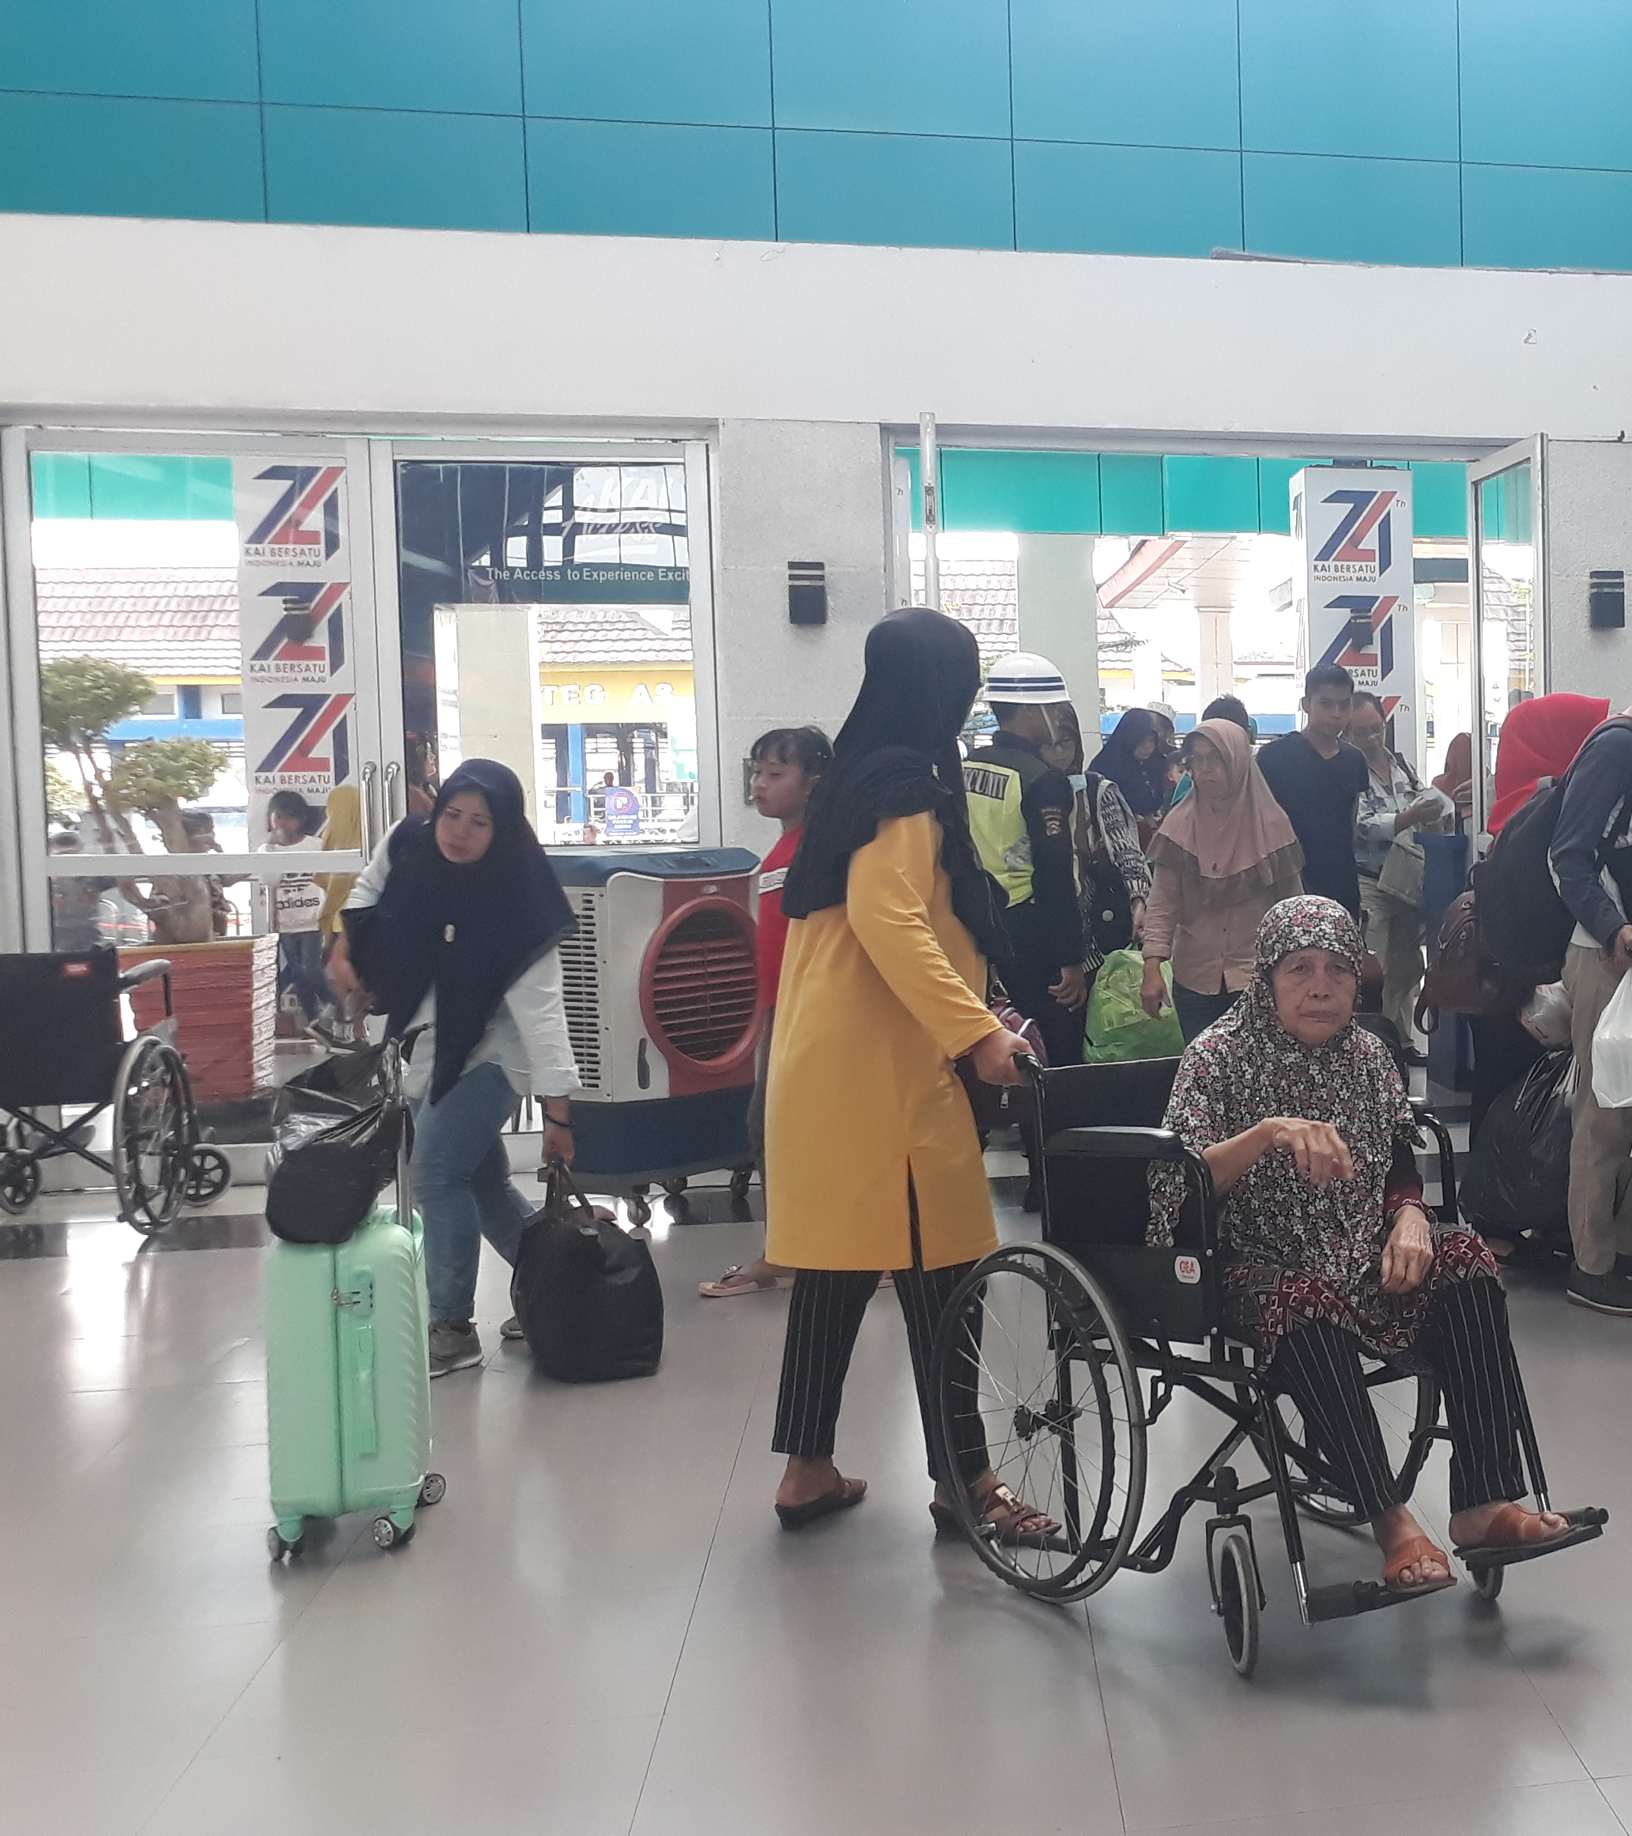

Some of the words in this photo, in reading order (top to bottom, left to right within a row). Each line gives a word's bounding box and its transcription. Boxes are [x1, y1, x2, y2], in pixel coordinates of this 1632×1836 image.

[245, 547, 265, 557] KAI
[270, 547, 320, 557] BERSATU
[1313, 564, 1331, 573] KAI
[1334, 564, 1376, 574] BERSATU
[486, 568, 510, 580] The
[513, 568, 561, 580] Access
[567, 568, 581, 580] to
[583, 568, 654, 584] Experience
[250, 663, 271, 673] KAI
[275, 663, 326, 673] BERSATU
[255, 775, 276, 785] KAI
[280, 774, 330, 785] BERSATU
[275, 896, 321, 911] adidas
[1180, 1261, 1196, 1274] GEA
